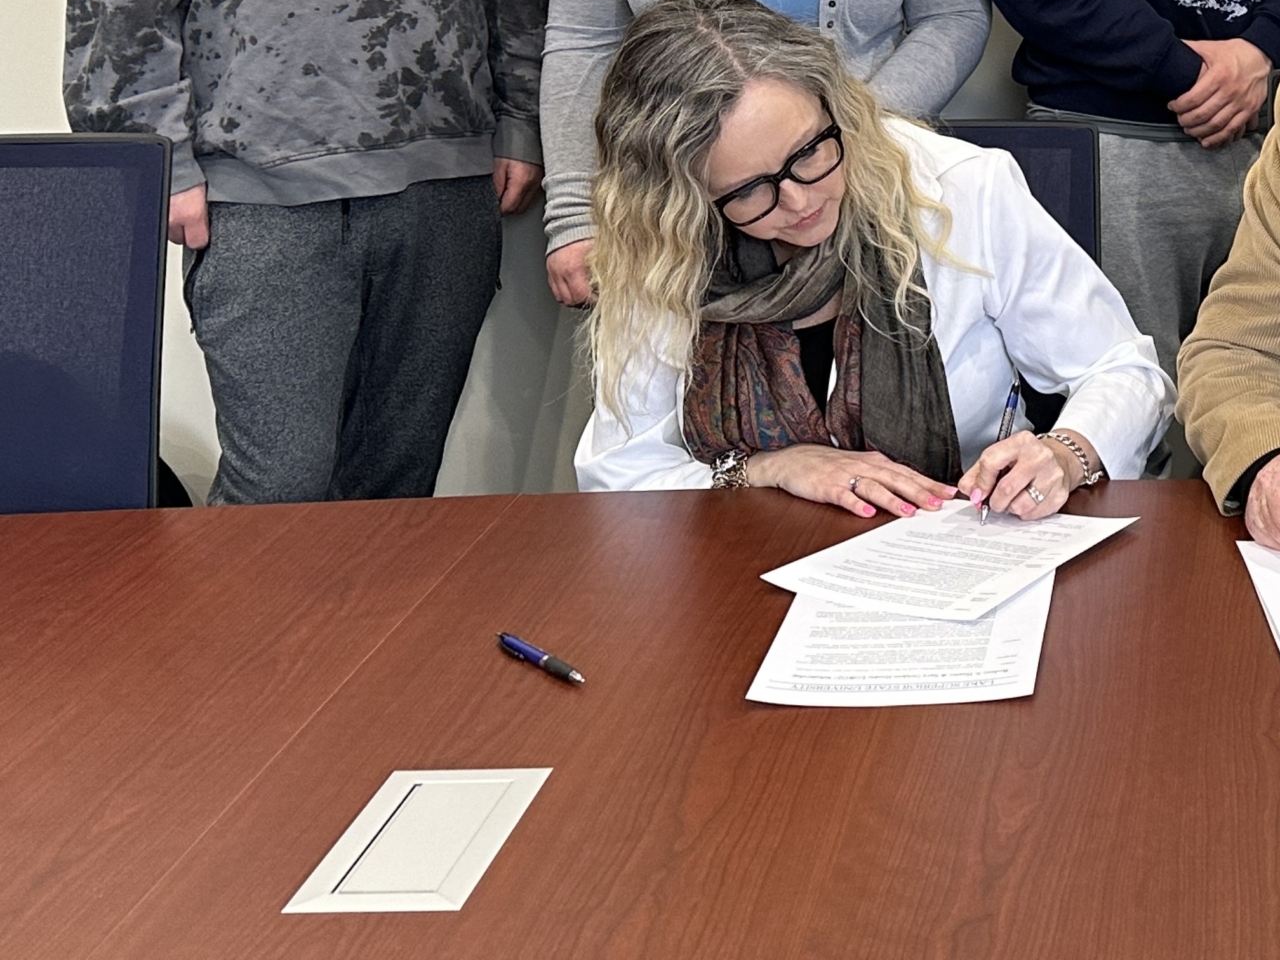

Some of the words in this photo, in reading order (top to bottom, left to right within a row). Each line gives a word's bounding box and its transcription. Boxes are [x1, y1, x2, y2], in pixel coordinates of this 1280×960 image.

[789, 683, 862, 692] UNIVERSITY
[865, 683, 900, 691] STATE
[902, 681, 961, 690] SUPERIOR
[965, 679, 995, 688] LAKE
